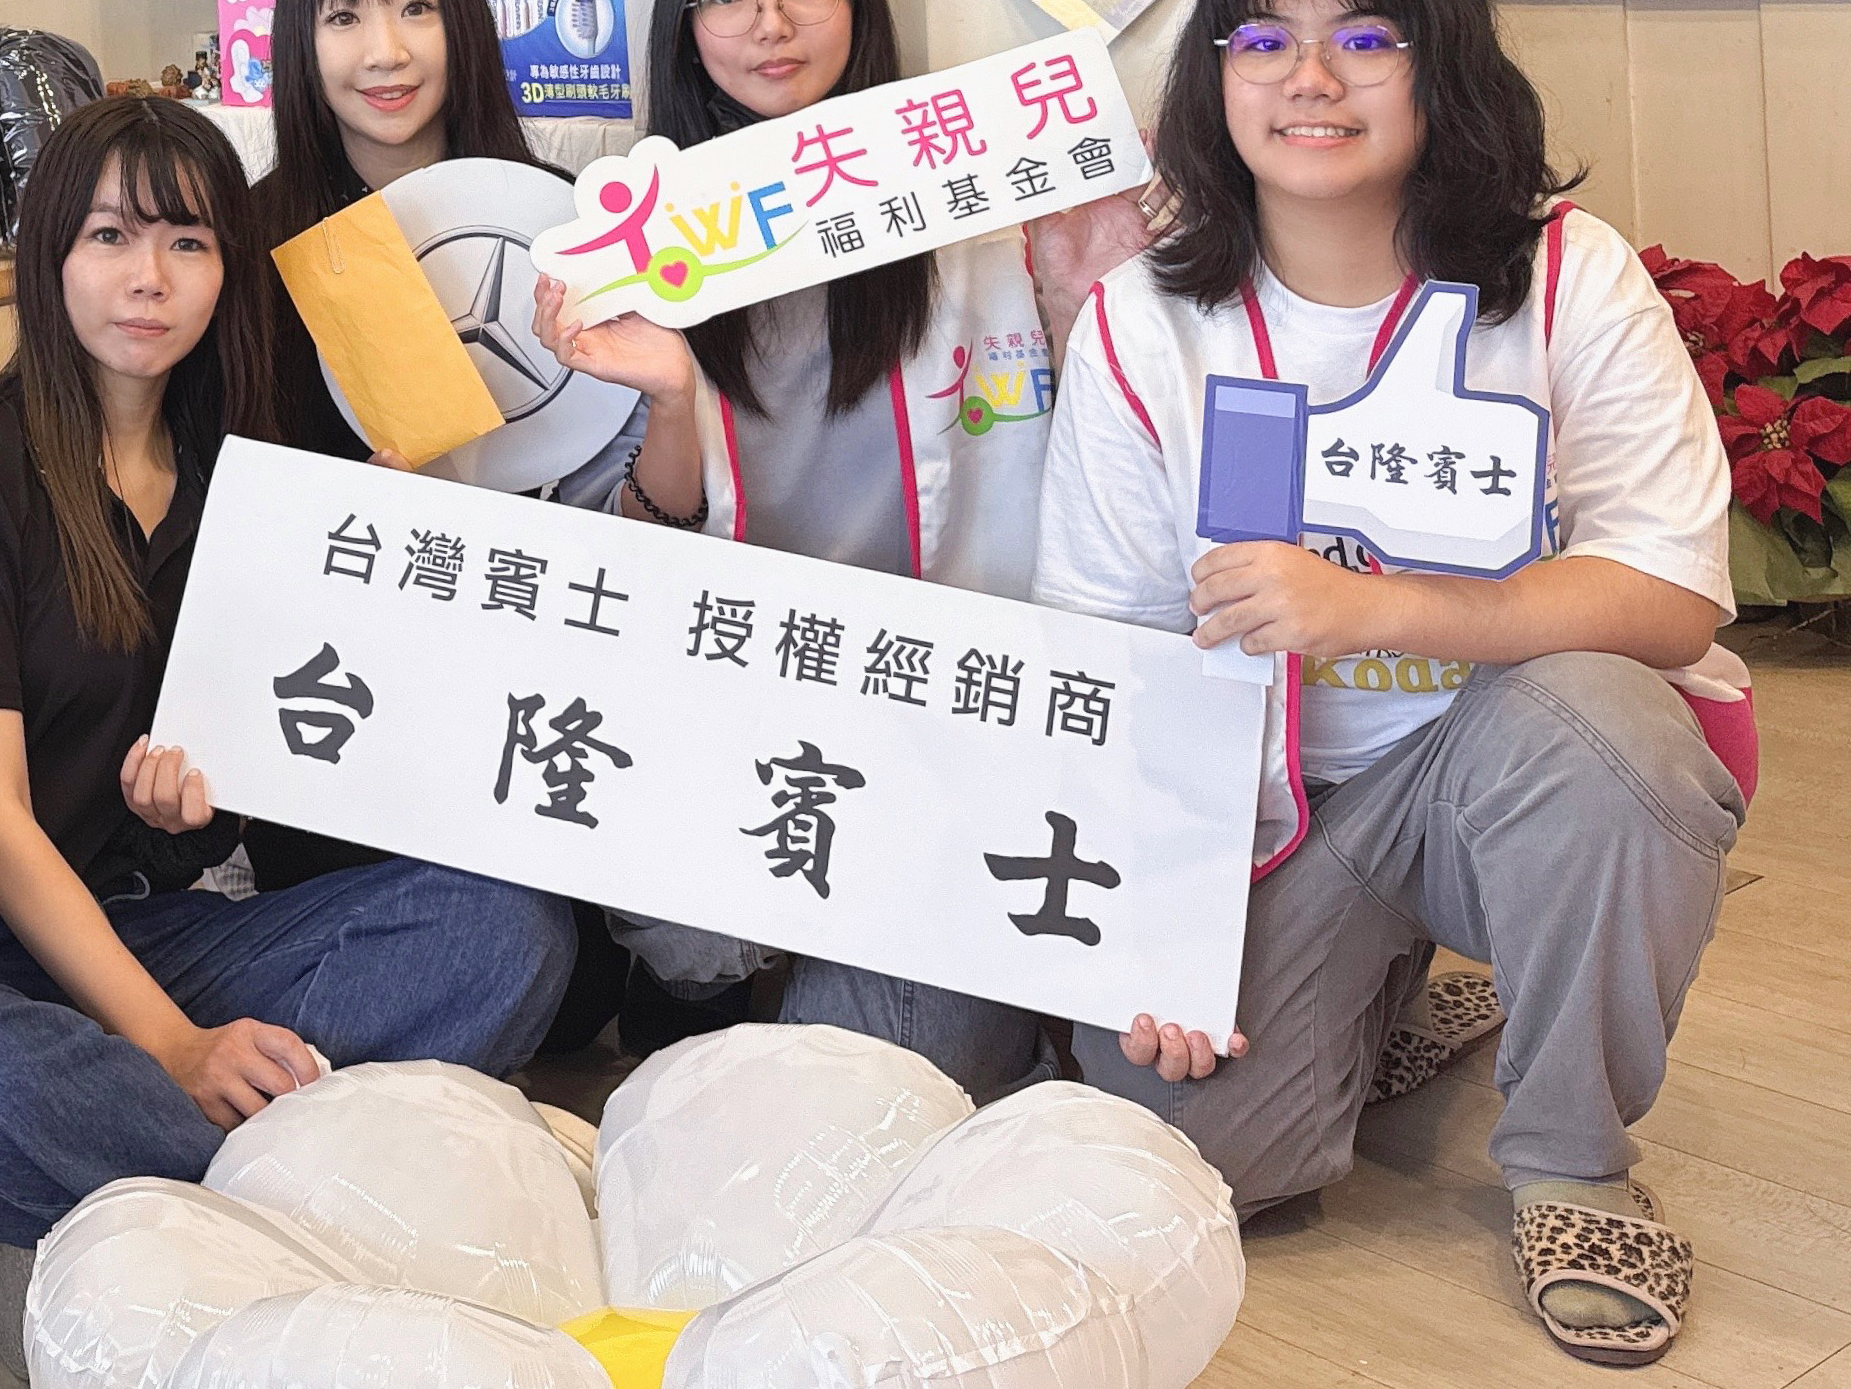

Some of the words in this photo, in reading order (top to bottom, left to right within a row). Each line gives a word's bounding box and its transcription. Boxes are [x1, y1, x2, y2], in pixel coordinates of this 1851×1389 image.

[529, 64, 622, 80] 專為敏感性牙齒設計
[791, 53, 1097, 209] 失親兒
[815, 136, 1118, 259] 福利基金會
[983, 329, 1046, 351] 失親兒
[1321, 437, 1517, 497] 台隆賓士
[322, 511, 632, 638] 台灣賓士
[686, 588, 1118, 747] 授權經銷商
[271, 640, 1123, 948] 台隆賓士
